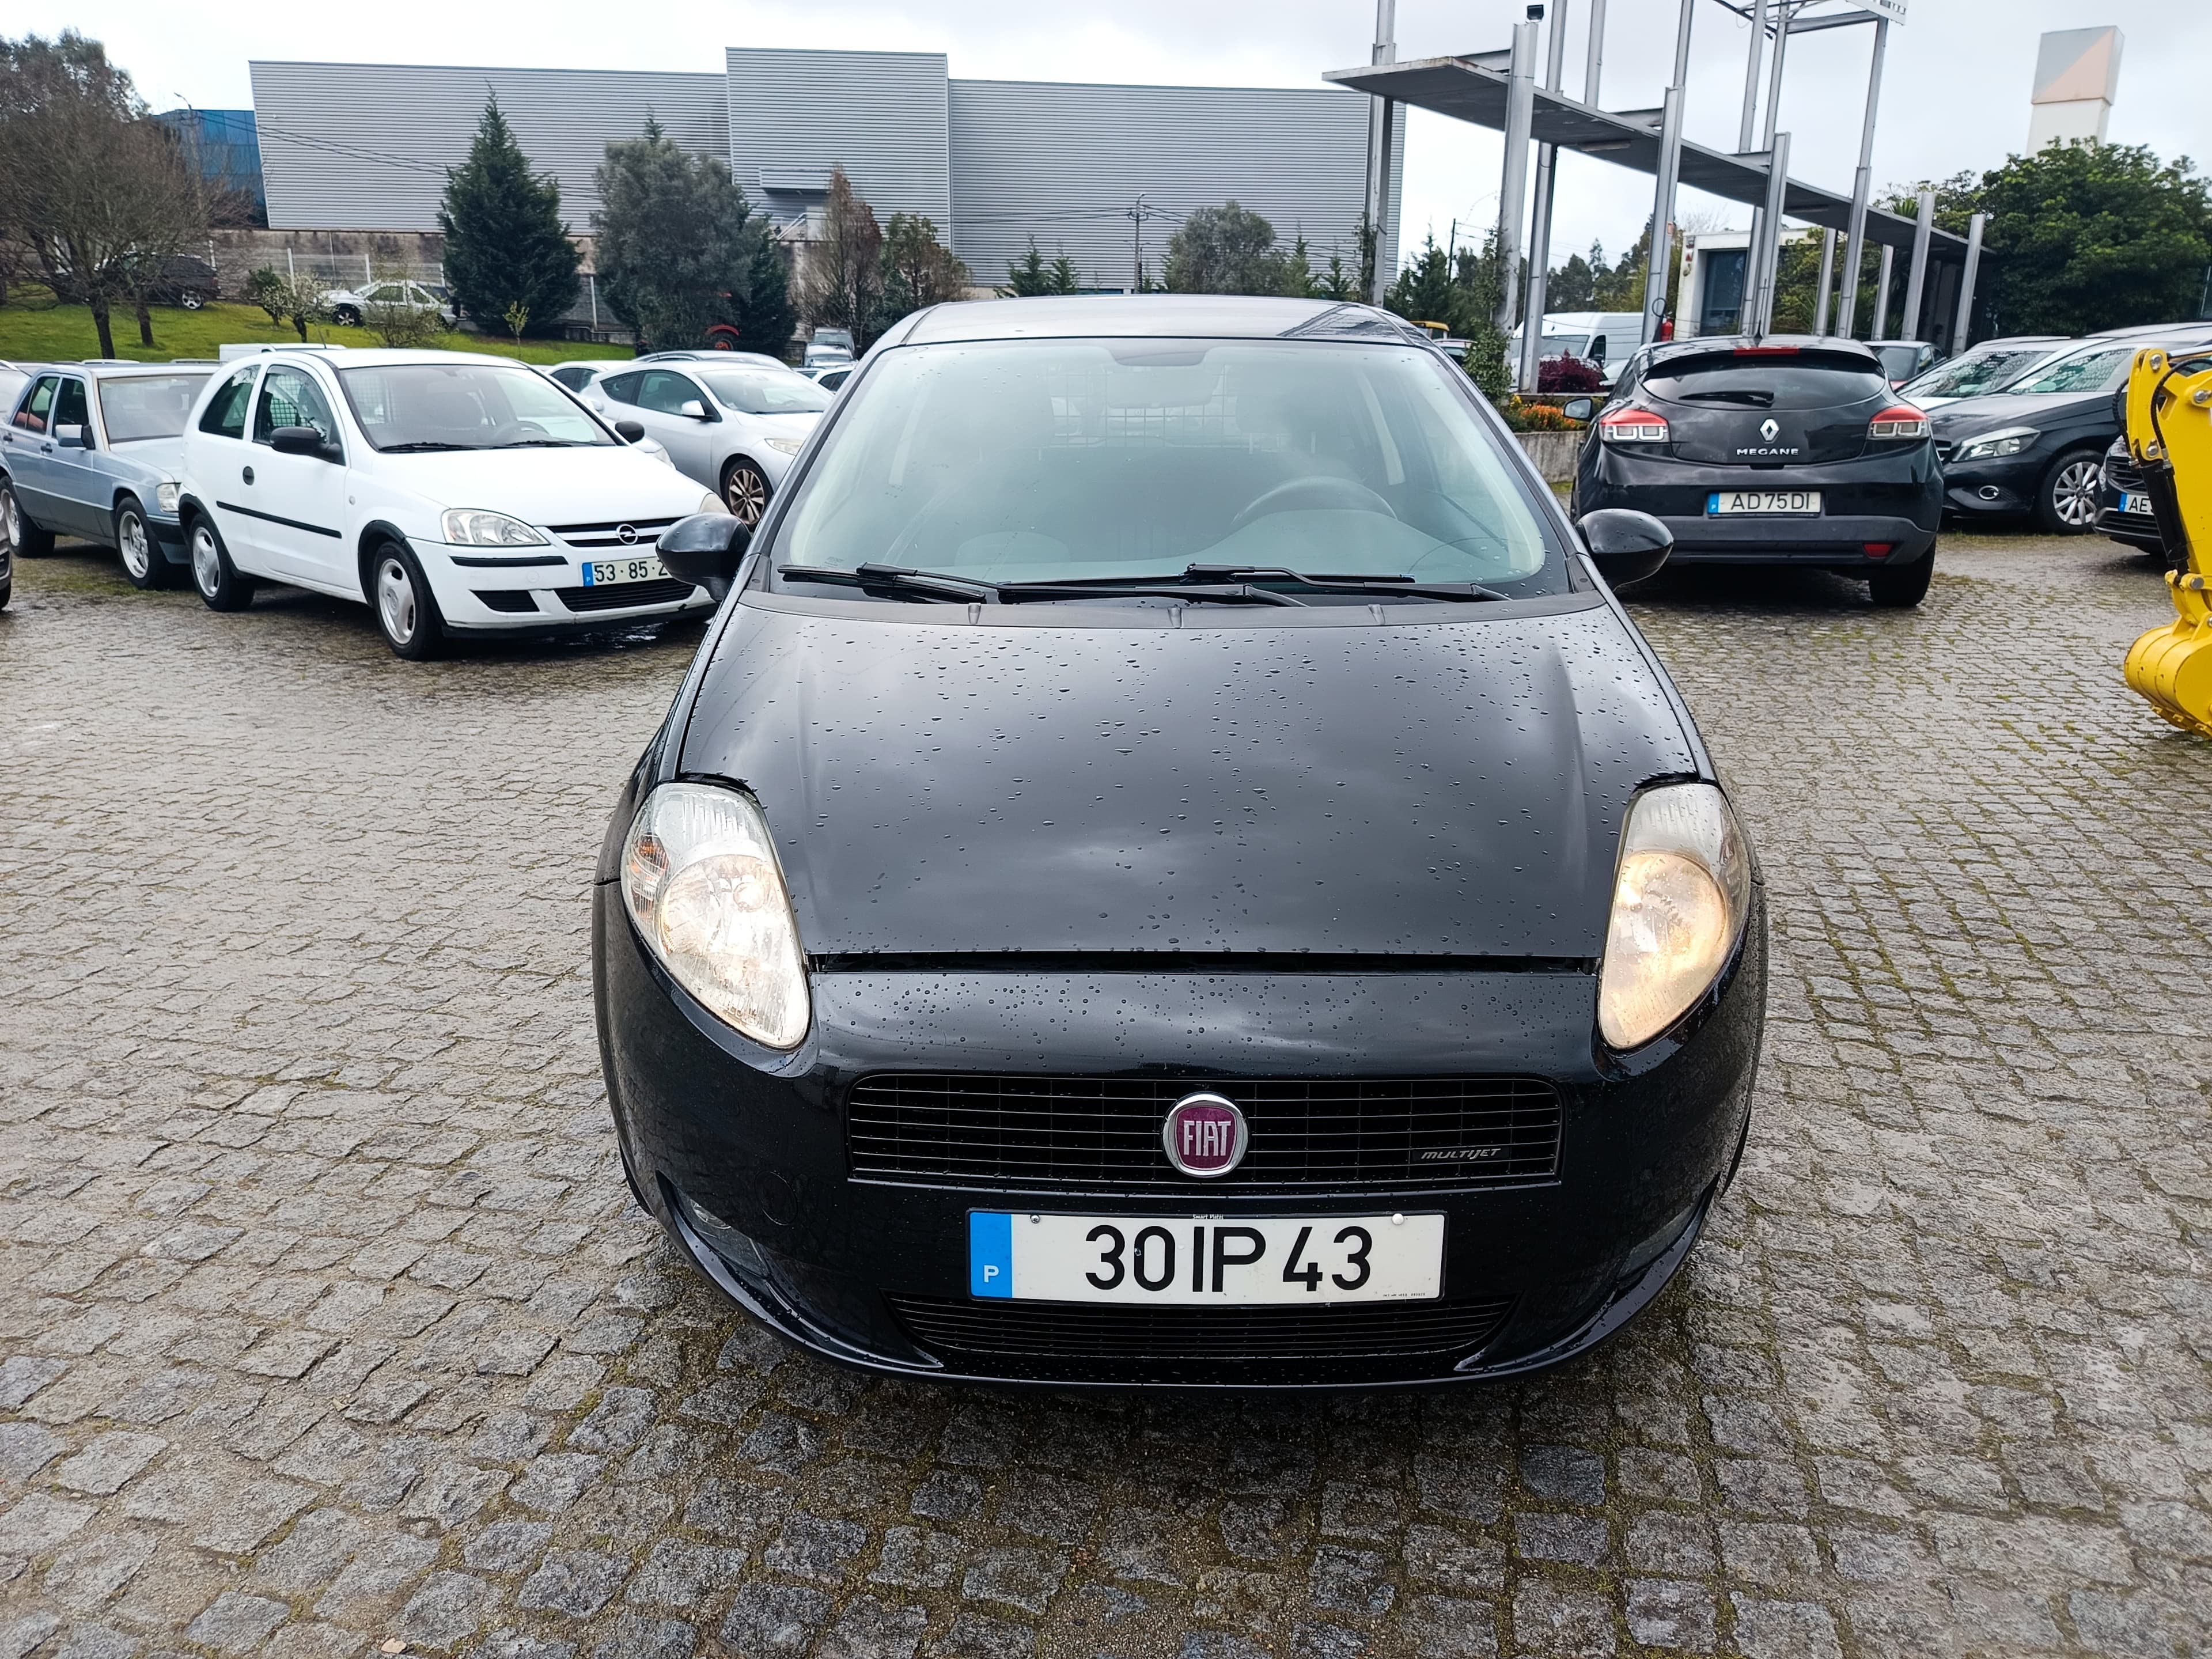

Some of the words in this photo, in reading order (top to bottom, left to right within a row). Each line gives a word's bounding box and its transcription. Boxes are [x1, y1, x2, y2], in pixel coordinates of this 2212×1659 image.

[2129, 497, 2150, 512] AE
[1184, 1120, 1232, 1156] FIAT
[1421, 1148, 1501, 1160] MULTIJET
[984, 1265, 999, 1282] P
